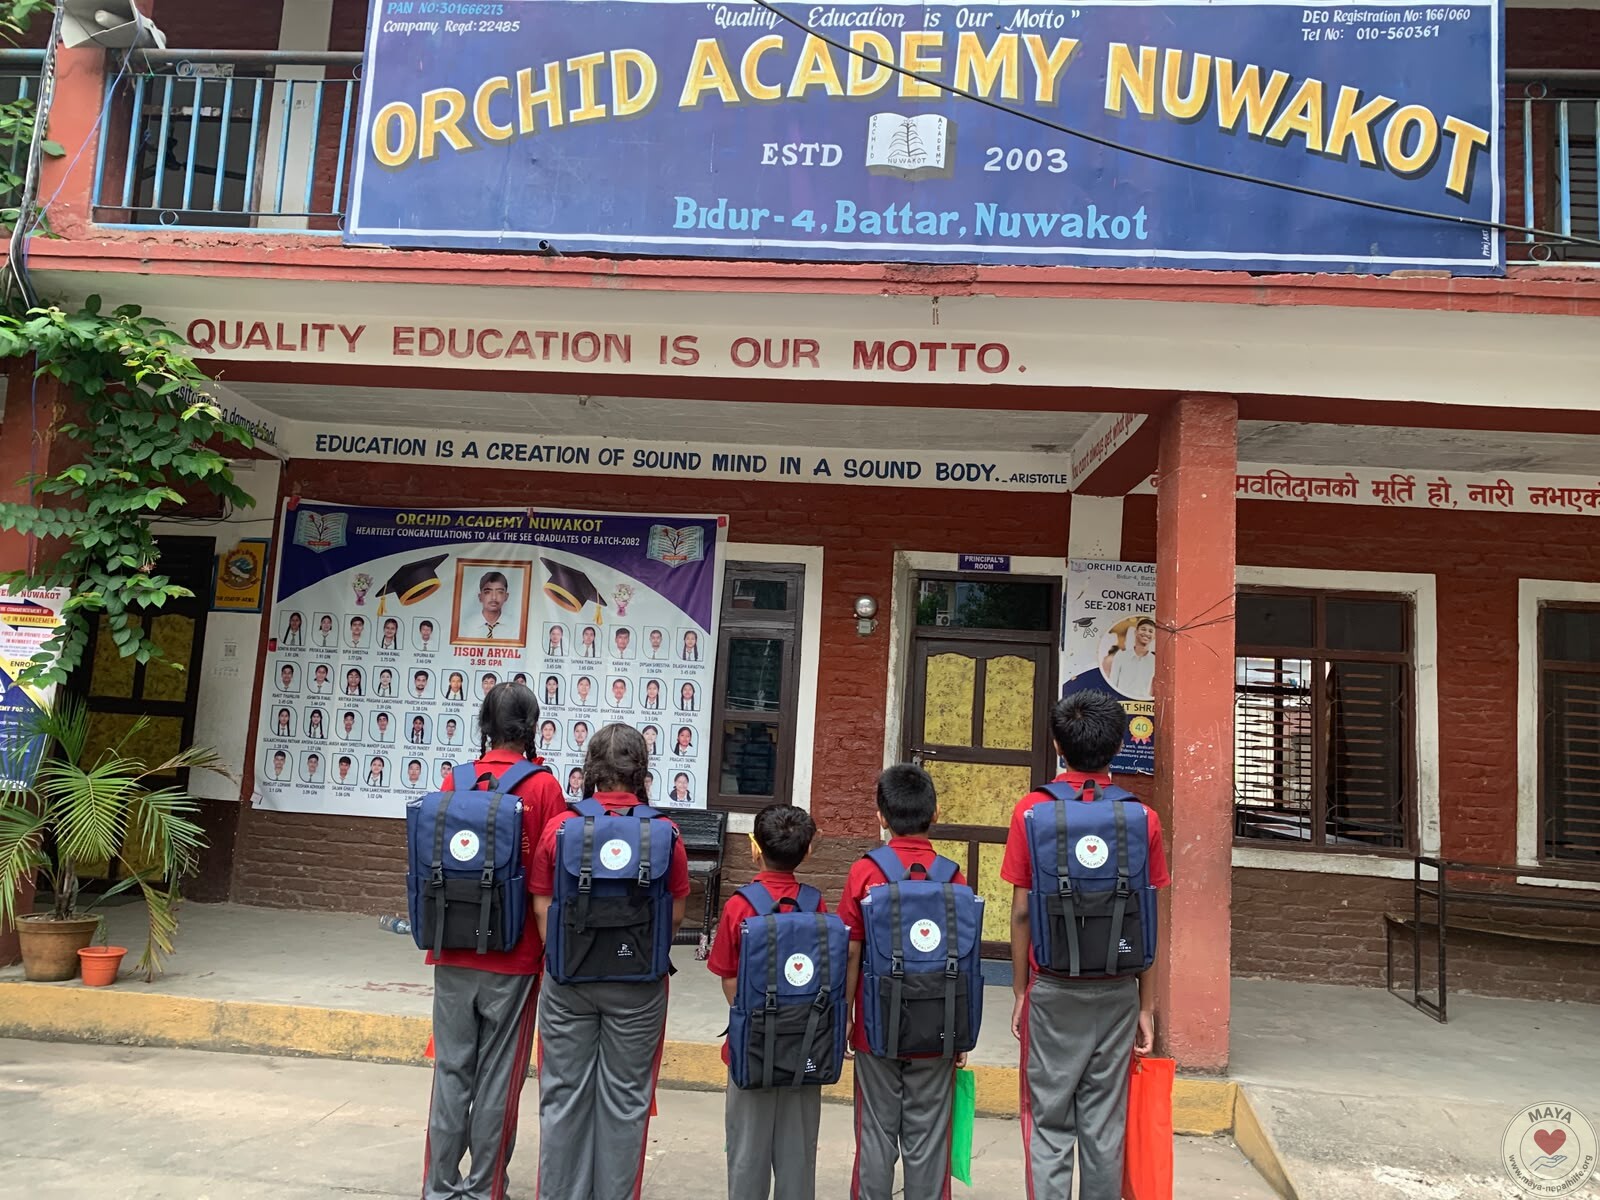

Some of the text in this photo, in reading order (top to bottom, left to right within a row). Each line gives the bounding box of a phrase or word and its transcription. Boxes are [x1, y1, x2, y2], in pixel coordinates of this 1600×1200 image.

[387, 3, 412, 14] PAN
[808, 6, 904, 28] Education
[925, 9, 942, 28] is
[956, 9, 993, 26] Our
[1302, 8, 1470, 25] DEO Registration No: 166/060
[383, 20, 439, 36] Company
[1302, 25, 1439, 41] Tel No: 010-560361
[371, 30, 1489, 196] ORCHID ACADEMY NUWAKOT
[762, 143, 843, 167] ESTD
[983, 148, 1068, 173] 2003
[975, 202, 1148, 240] Nuwakot
[187, 319, 1027, 373] QUALITY EDUCATION IS OUR MOTTO.
[315, 434, 426, 456] EDUCATION
[436, 440, 453, 458] IS
[461, 441, 479, 459] A
[487, 443, 589, 465] CREATION
[598, 448, 624, 466] OF
[632, 450, 700, 471] SOUND
[712, 453, 767, 473] MIND
[780, 457, 801, 475] IN
[813, 459, 832, 476] A
[844, 459, 922, 479] SOUND
[1371, 474, 1416, 504] मूर्ति
[1467, 479, 1514, 507] नारी
[395, 513, 603, 532] ORCHID ACADEMY NUWAKOT
[356, 527, 640, 546] HEARTIEST CONGRATULATIONS TO ALL THE SEE GRADUATES OF BATCH-2082
[1087, 563, 1157, 573] ORCHID ACADE
[1084, 600, 1131, 612] SEE-2081
[453, 647, 522, 659] JISON ARYAL
[1135, 723, 1148, 732] 40
